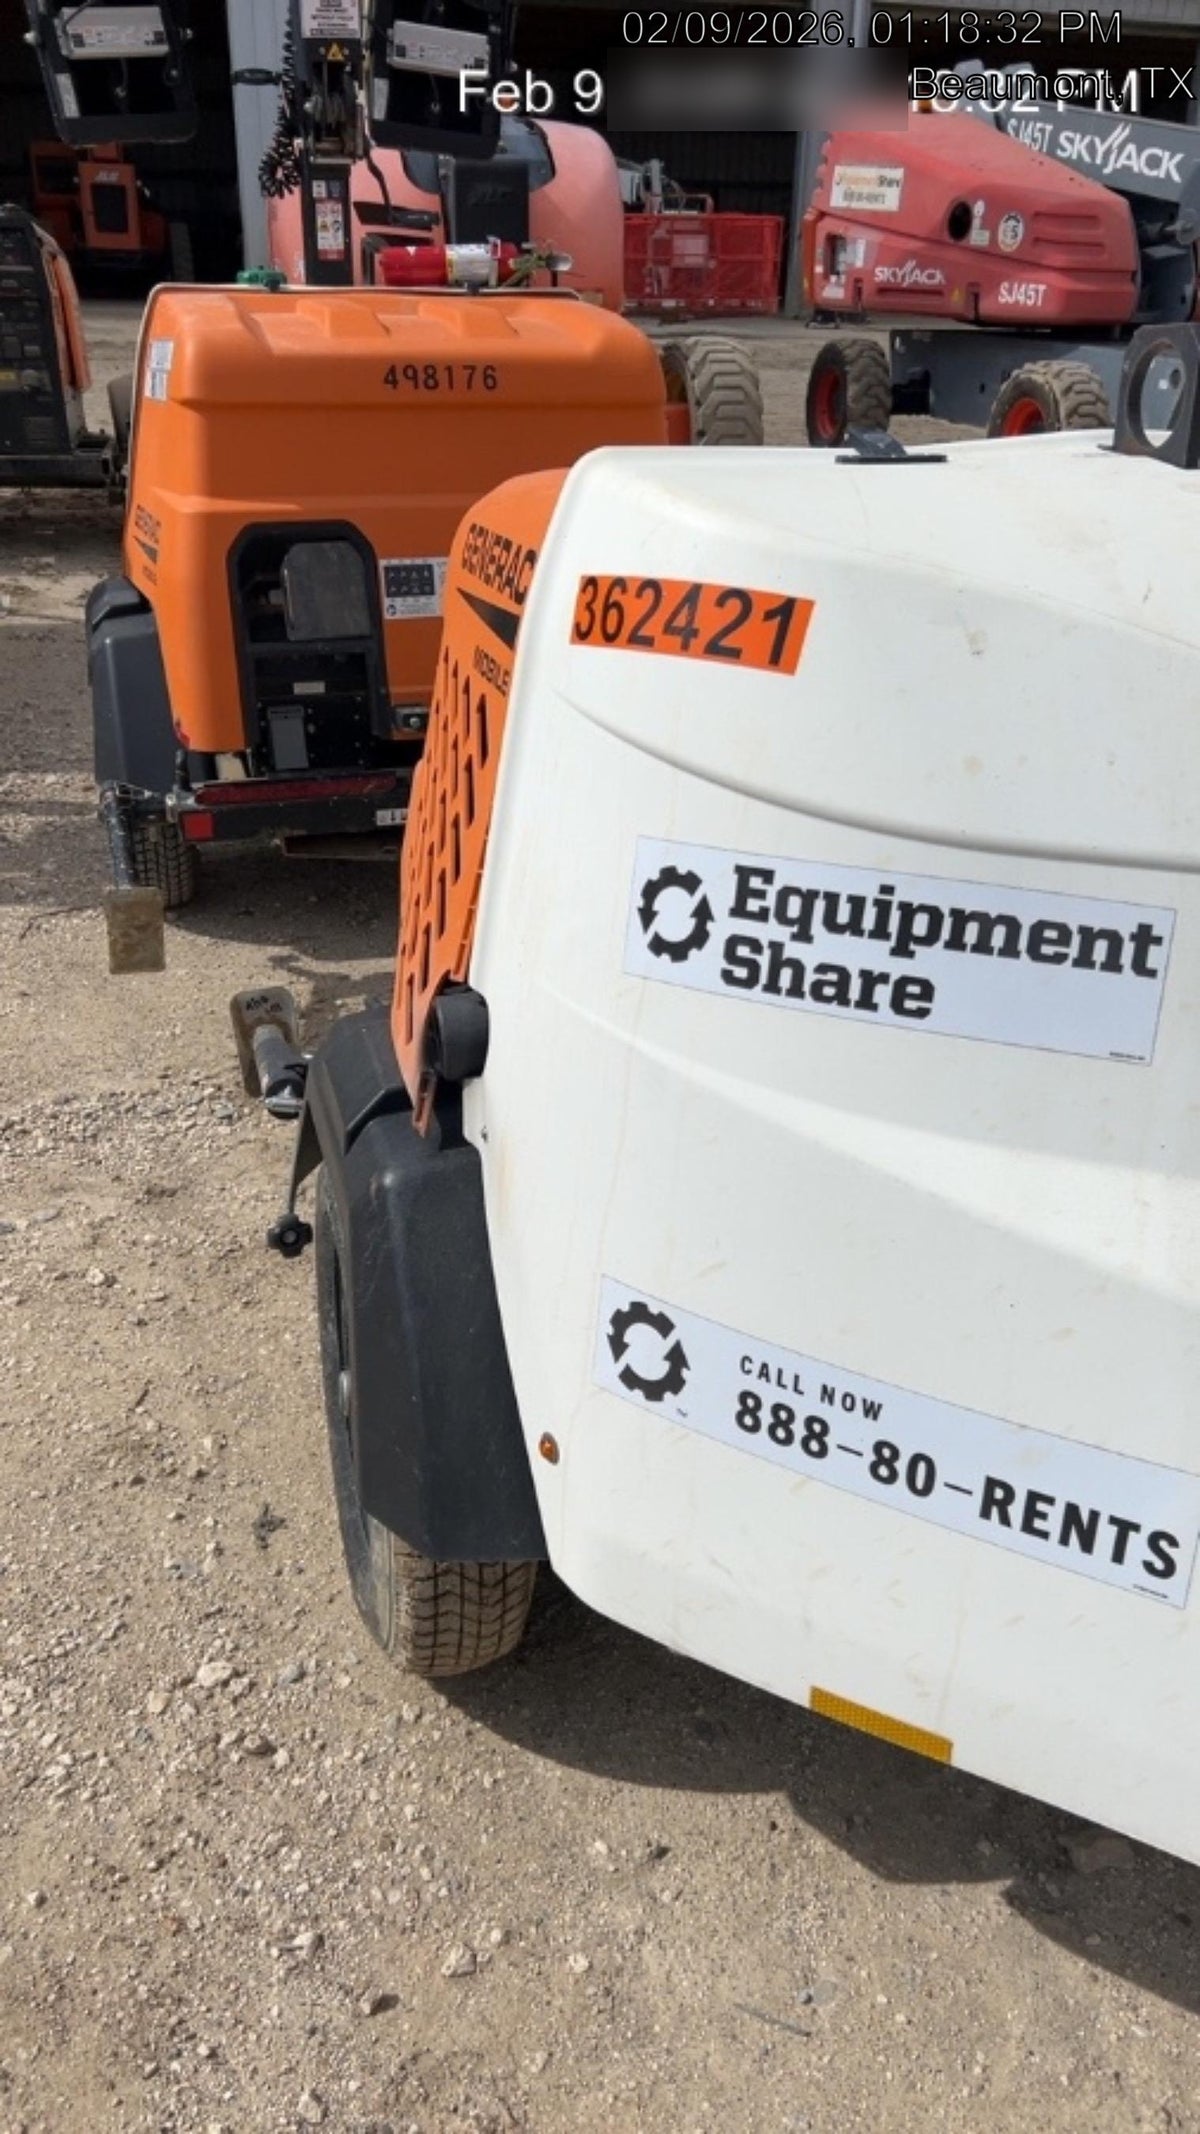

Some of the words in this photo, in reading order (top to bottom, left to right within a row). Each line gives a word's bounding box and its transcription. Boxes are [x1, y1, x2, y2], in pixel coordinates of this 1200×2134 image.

[1057, 122, 1185, 183] SKYJACK
[874, 259, 947, 288] SKYJACK
[998, 282, 1047, 307] SJ45T
[383, 364, 498, 391] 498176
[462, 523, 539, 606] GENERAC
[575, 575, 797, 667] 362421
[729, 864, 1164, 979] Equipment
[720, 933, 935, 1020] Share
[740, 1355, 805, 1396] CALL
[820, 1383, 884, 1422] NOW
[735, 1389, 1180, 1581] 888-80-RENTS
